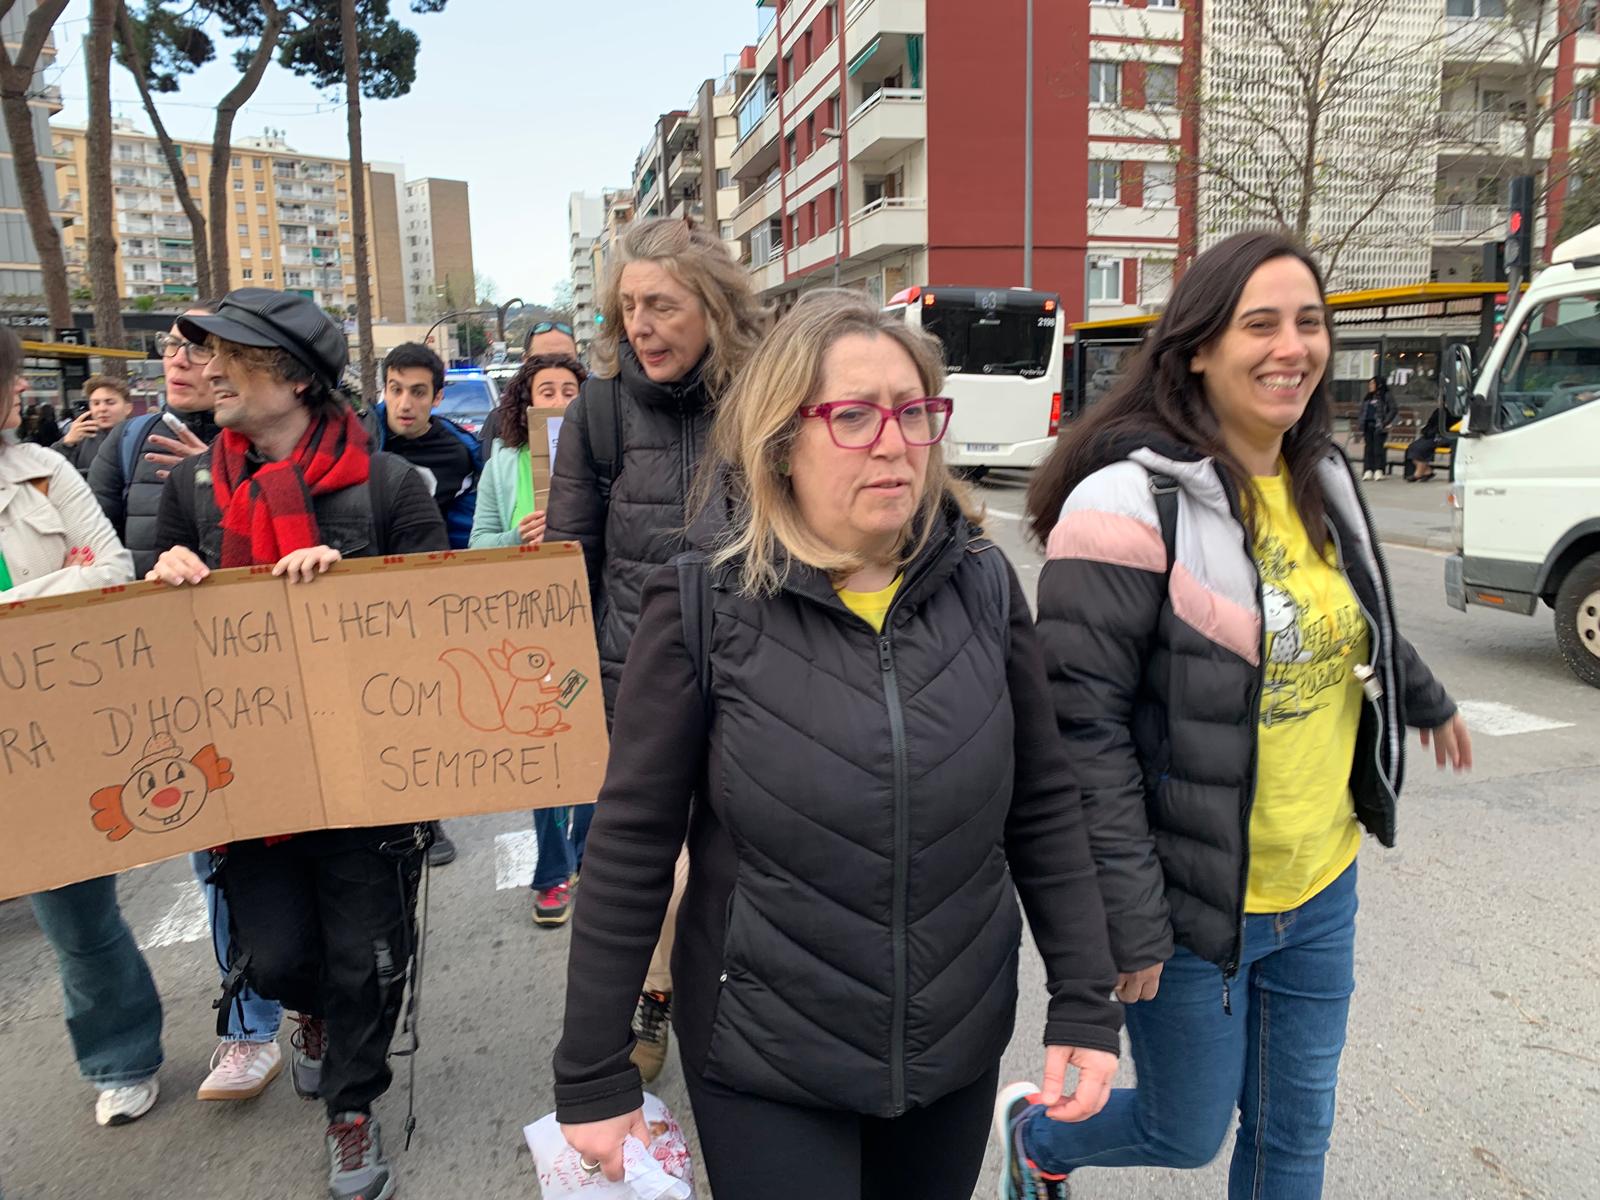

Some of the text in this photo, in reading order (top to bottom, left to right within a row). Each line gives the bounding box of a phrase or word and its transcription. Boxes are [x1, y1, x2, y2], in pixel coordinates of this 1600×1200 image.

[193, 611, 282, 657] VAGA
[304, 599, 416, 644] L'HEM
[428, 579, 588, 637] PREPARADA
[0, 720, 55, 775] RA
[361, 672, 443, 717] COM
[379, 741, 562, 792] SEMPRE!
